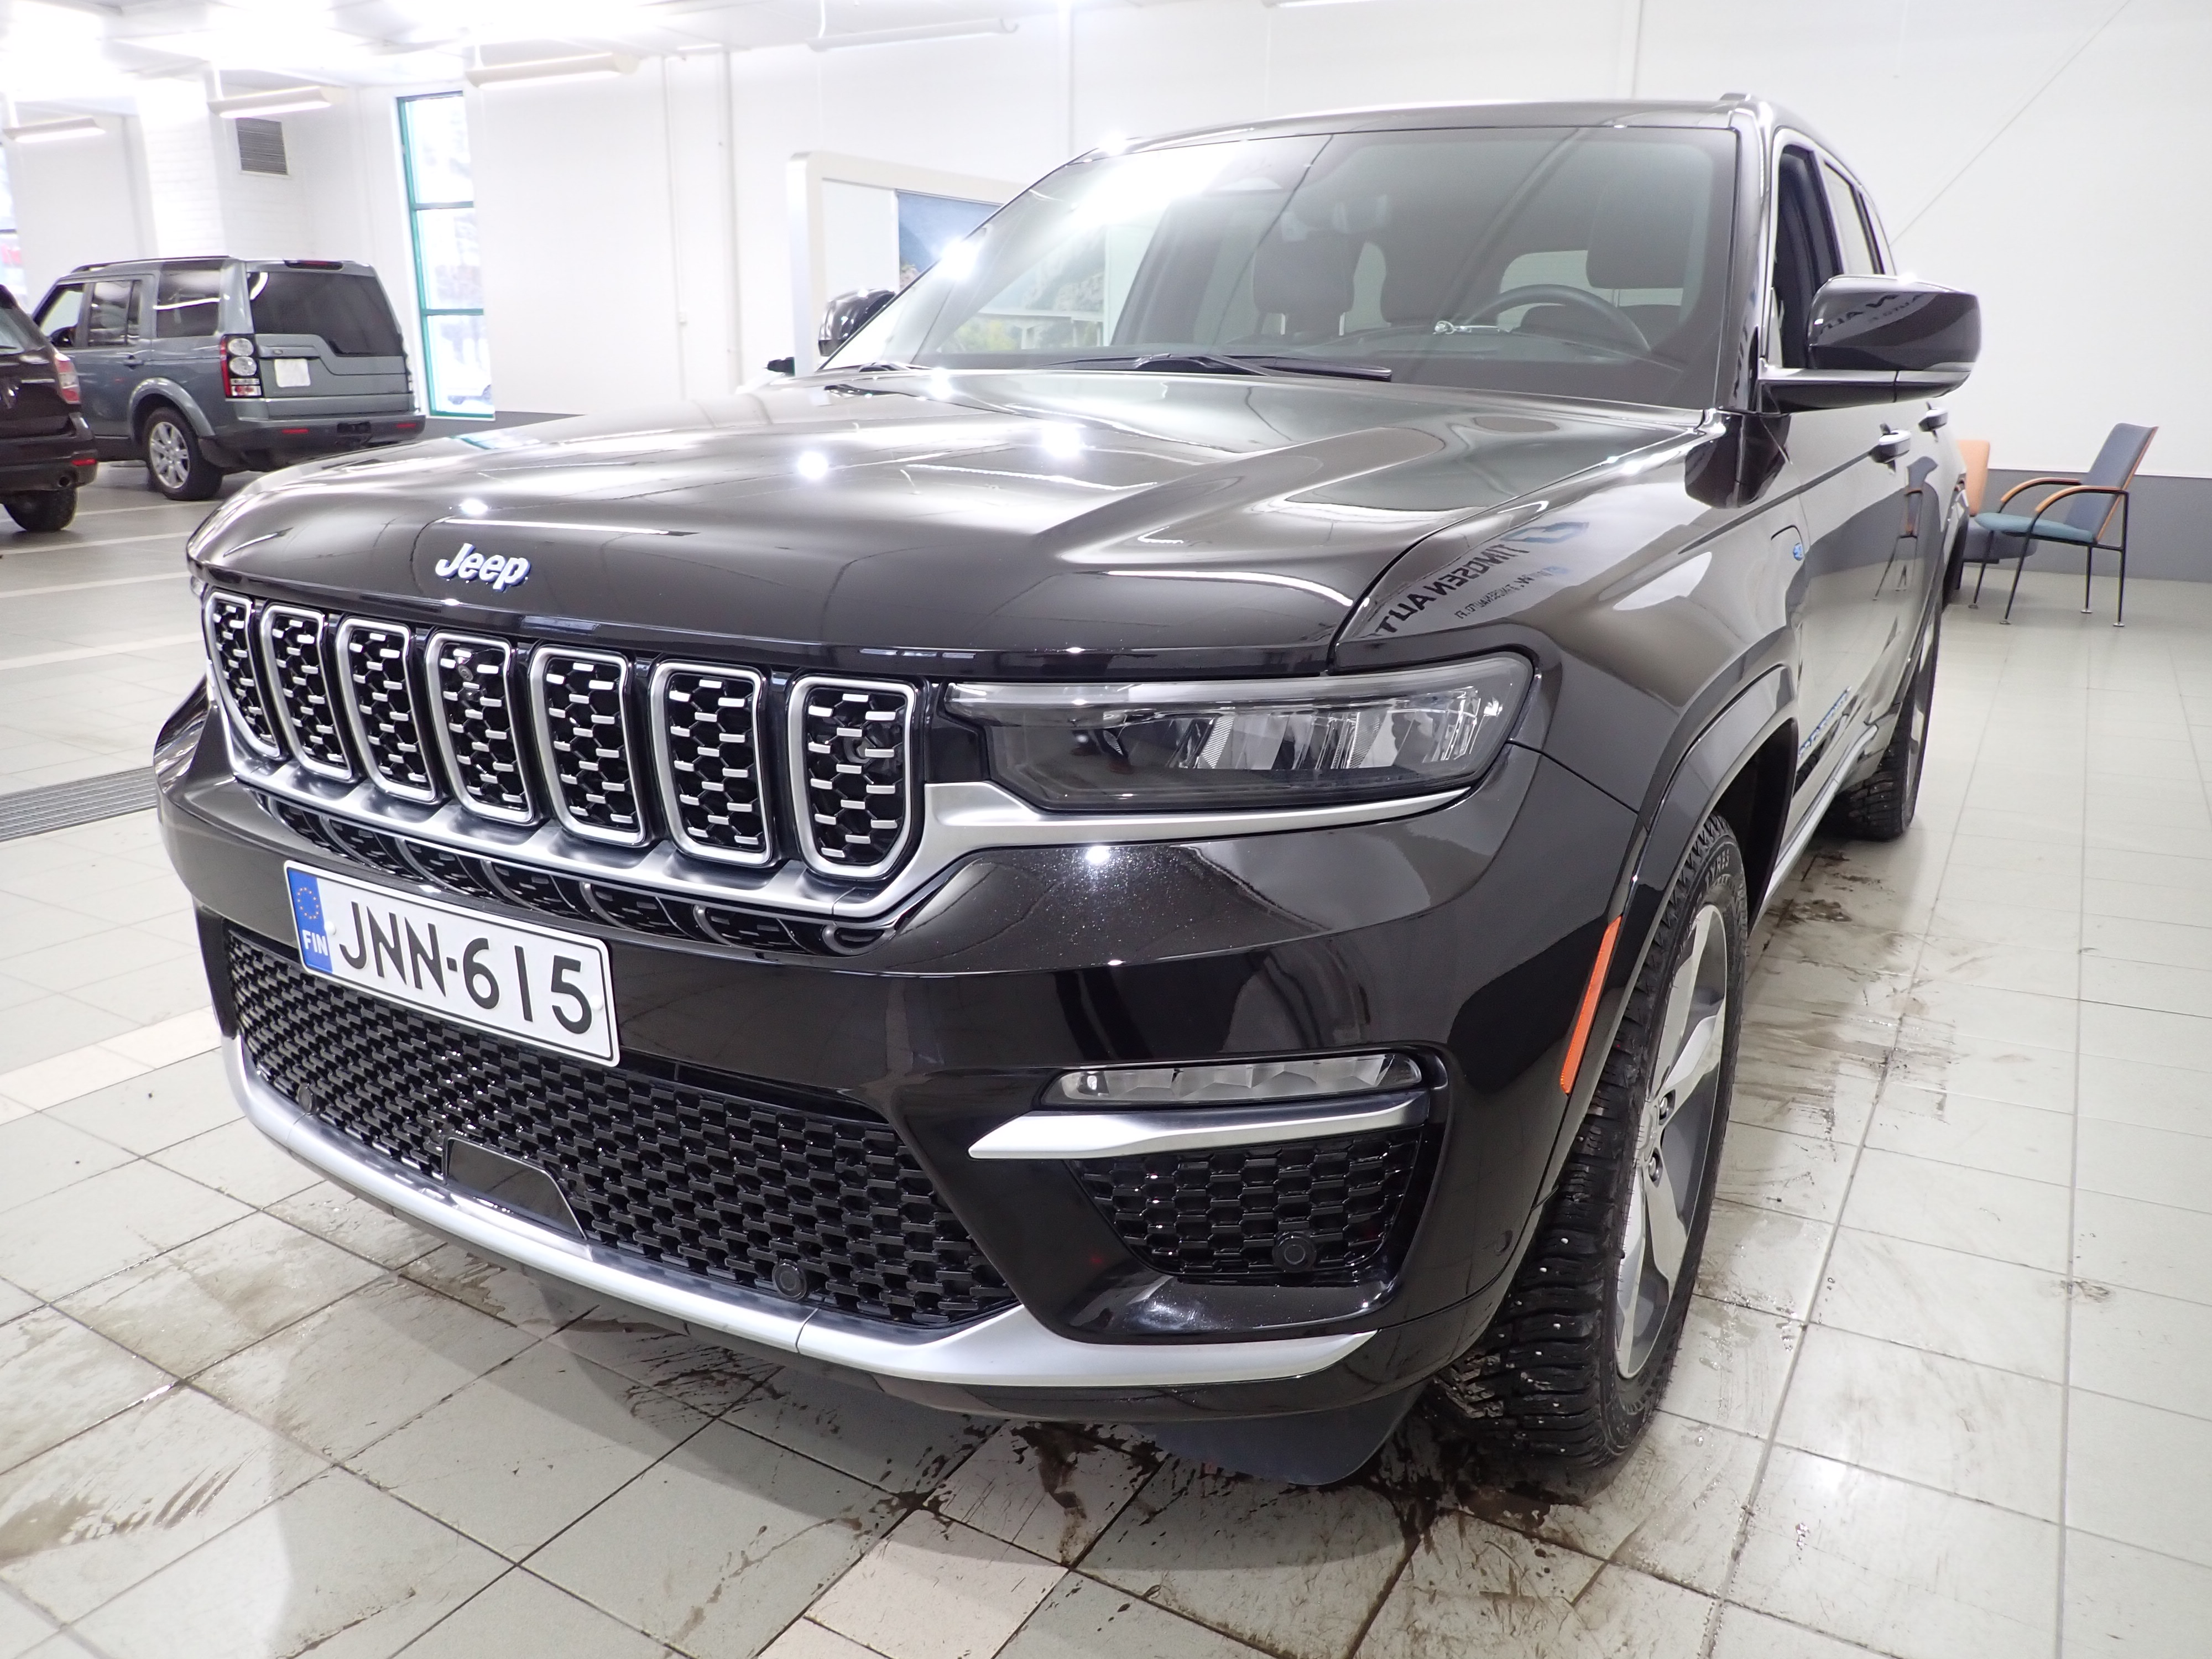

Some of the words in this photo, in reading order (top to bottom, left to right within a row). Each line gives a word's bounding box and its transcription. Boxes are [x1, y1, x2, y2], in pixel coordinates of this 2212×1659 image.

[435, 542, 531, 592] Jeep
[302, 930, 329, 957] FIN
[339, 900, 593, 1035] JNN-615
